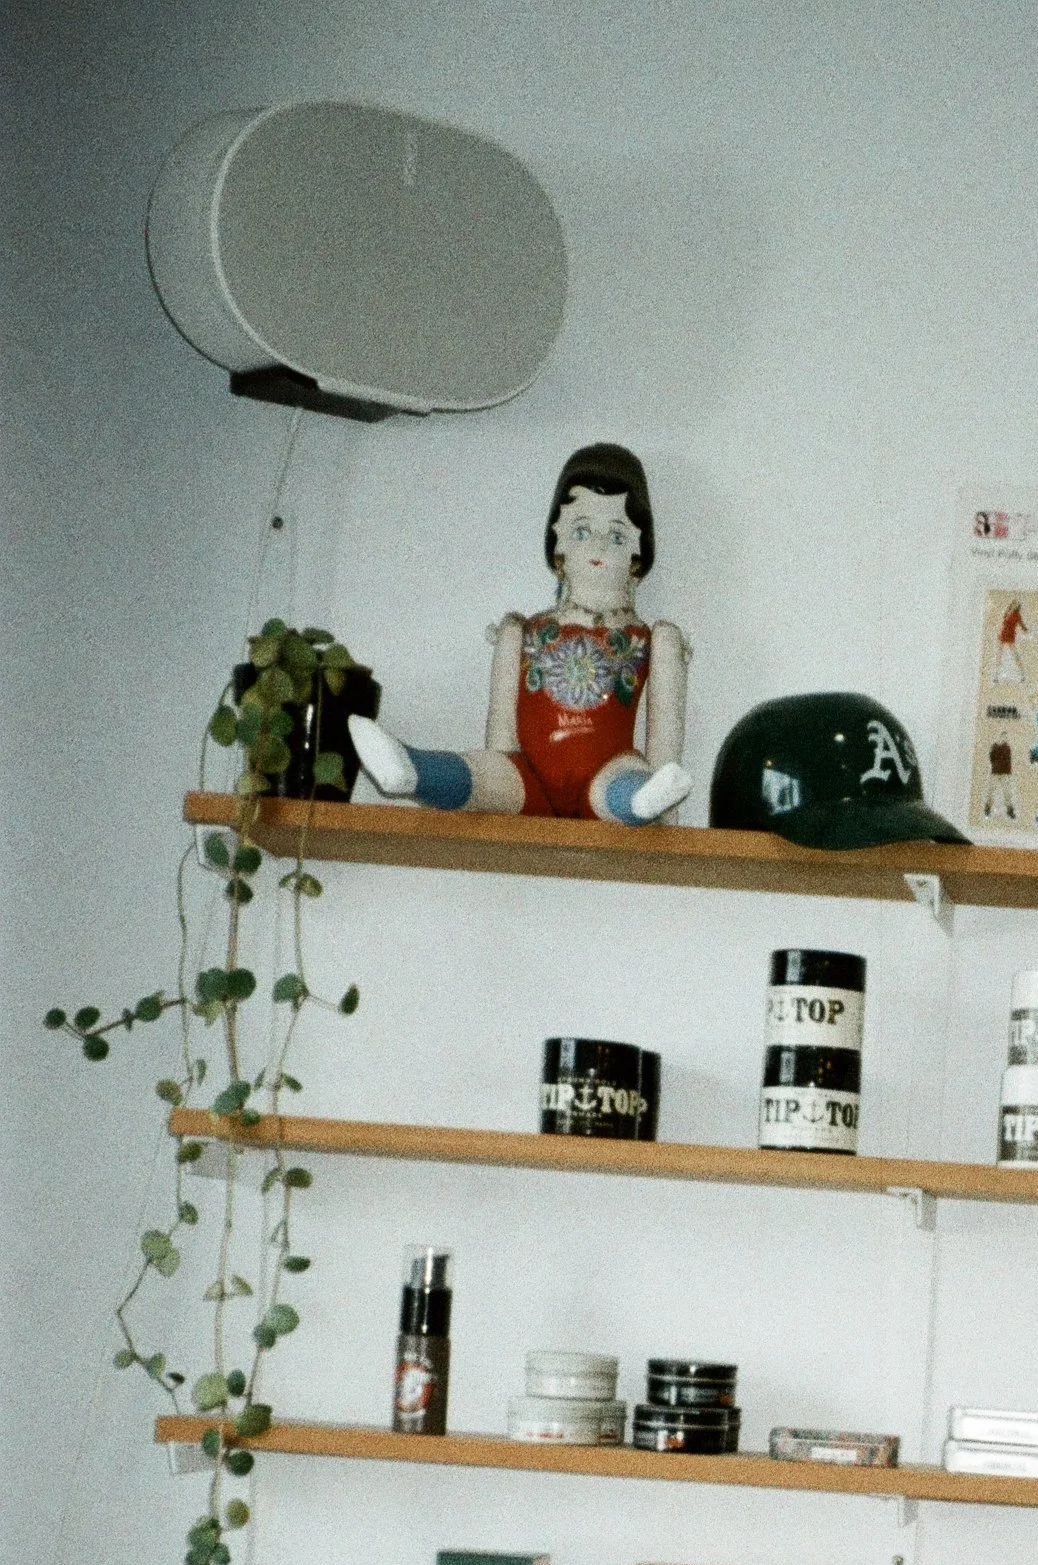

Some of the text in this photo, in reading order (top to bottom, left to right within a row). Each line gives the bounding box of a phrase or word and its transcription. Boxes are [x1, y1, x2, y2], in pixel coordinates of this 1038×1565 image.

[794, 997, 845, 1025] TOP
[541, 1082, 575, 1111] TIP
[597, 1085, 641, 1116] TOP
[764, 1097, 800, 1123] TIP
